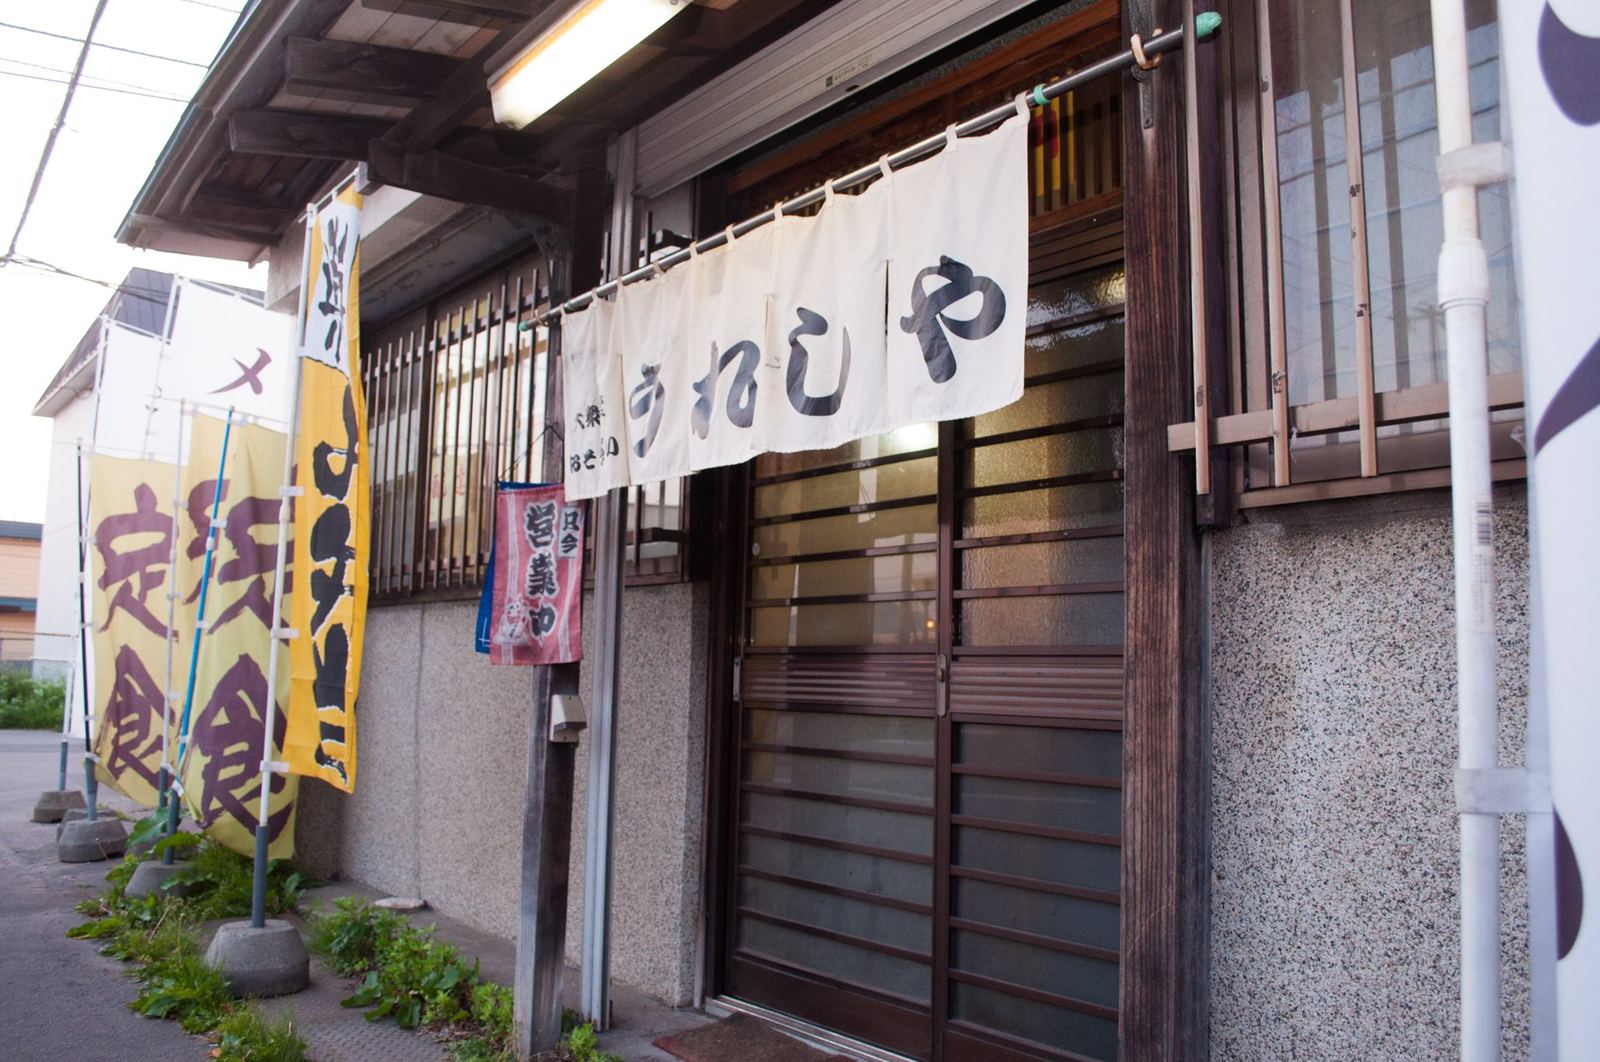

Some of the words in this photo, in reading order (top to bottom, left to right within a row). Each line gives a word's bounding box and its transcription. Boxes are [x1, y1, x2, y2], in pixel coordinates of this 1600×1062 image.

[628, 254, 1007, 459] うれしや
[526, 502, 558, 639] 営業中
[561, 511, 580, 554] 只今
[94, 482, 181, 793] 定食
